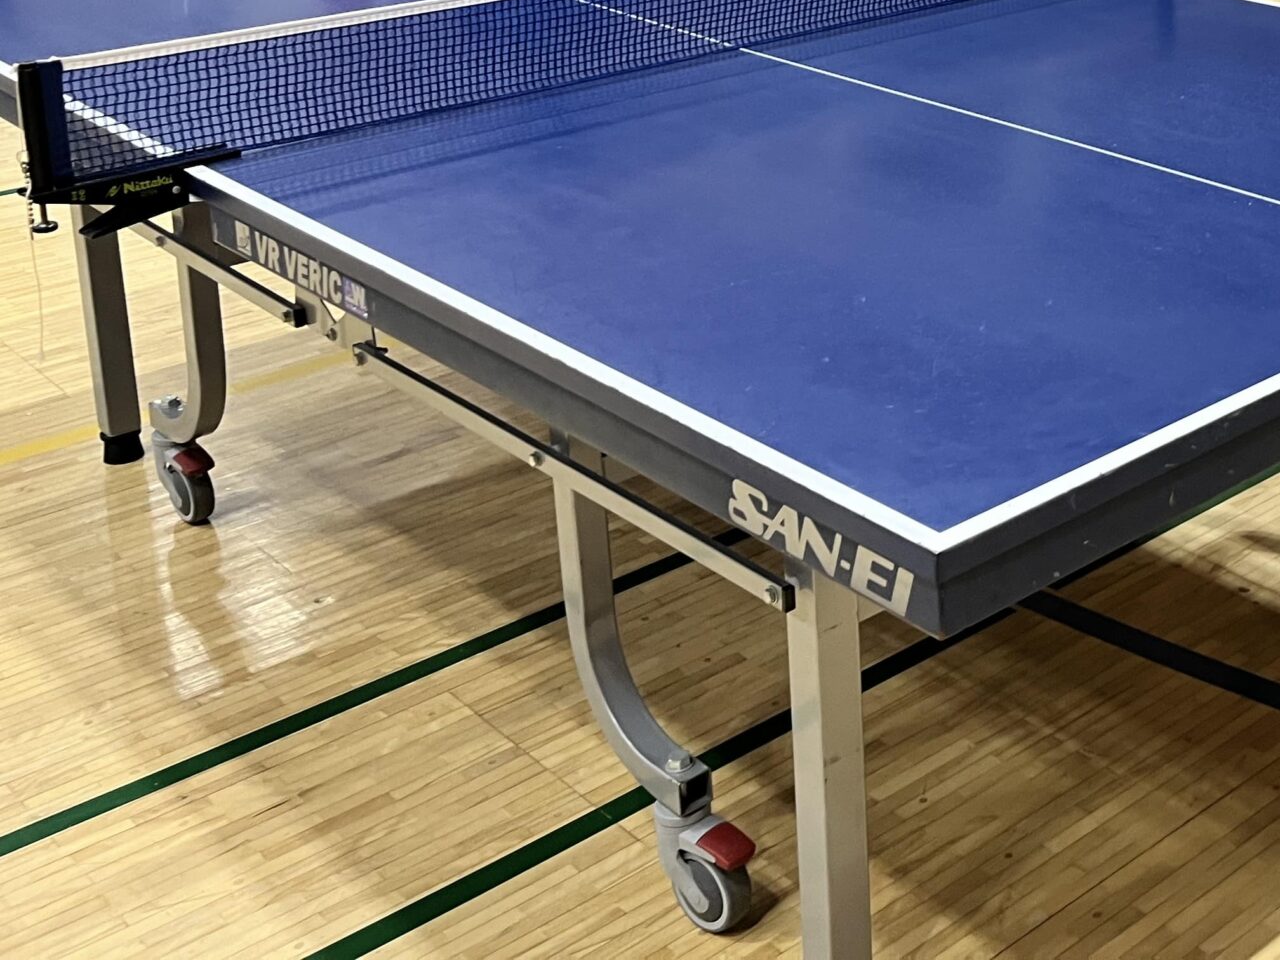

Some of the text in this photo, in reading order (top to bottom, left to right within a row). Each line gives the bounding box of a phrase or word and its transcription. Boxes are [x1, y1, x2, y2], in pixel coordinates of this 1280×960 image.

[123, 176, 173, 194] Nittaku
[254, 230, 280, 273] VR
[283, 246, 342, 304] VERIC
